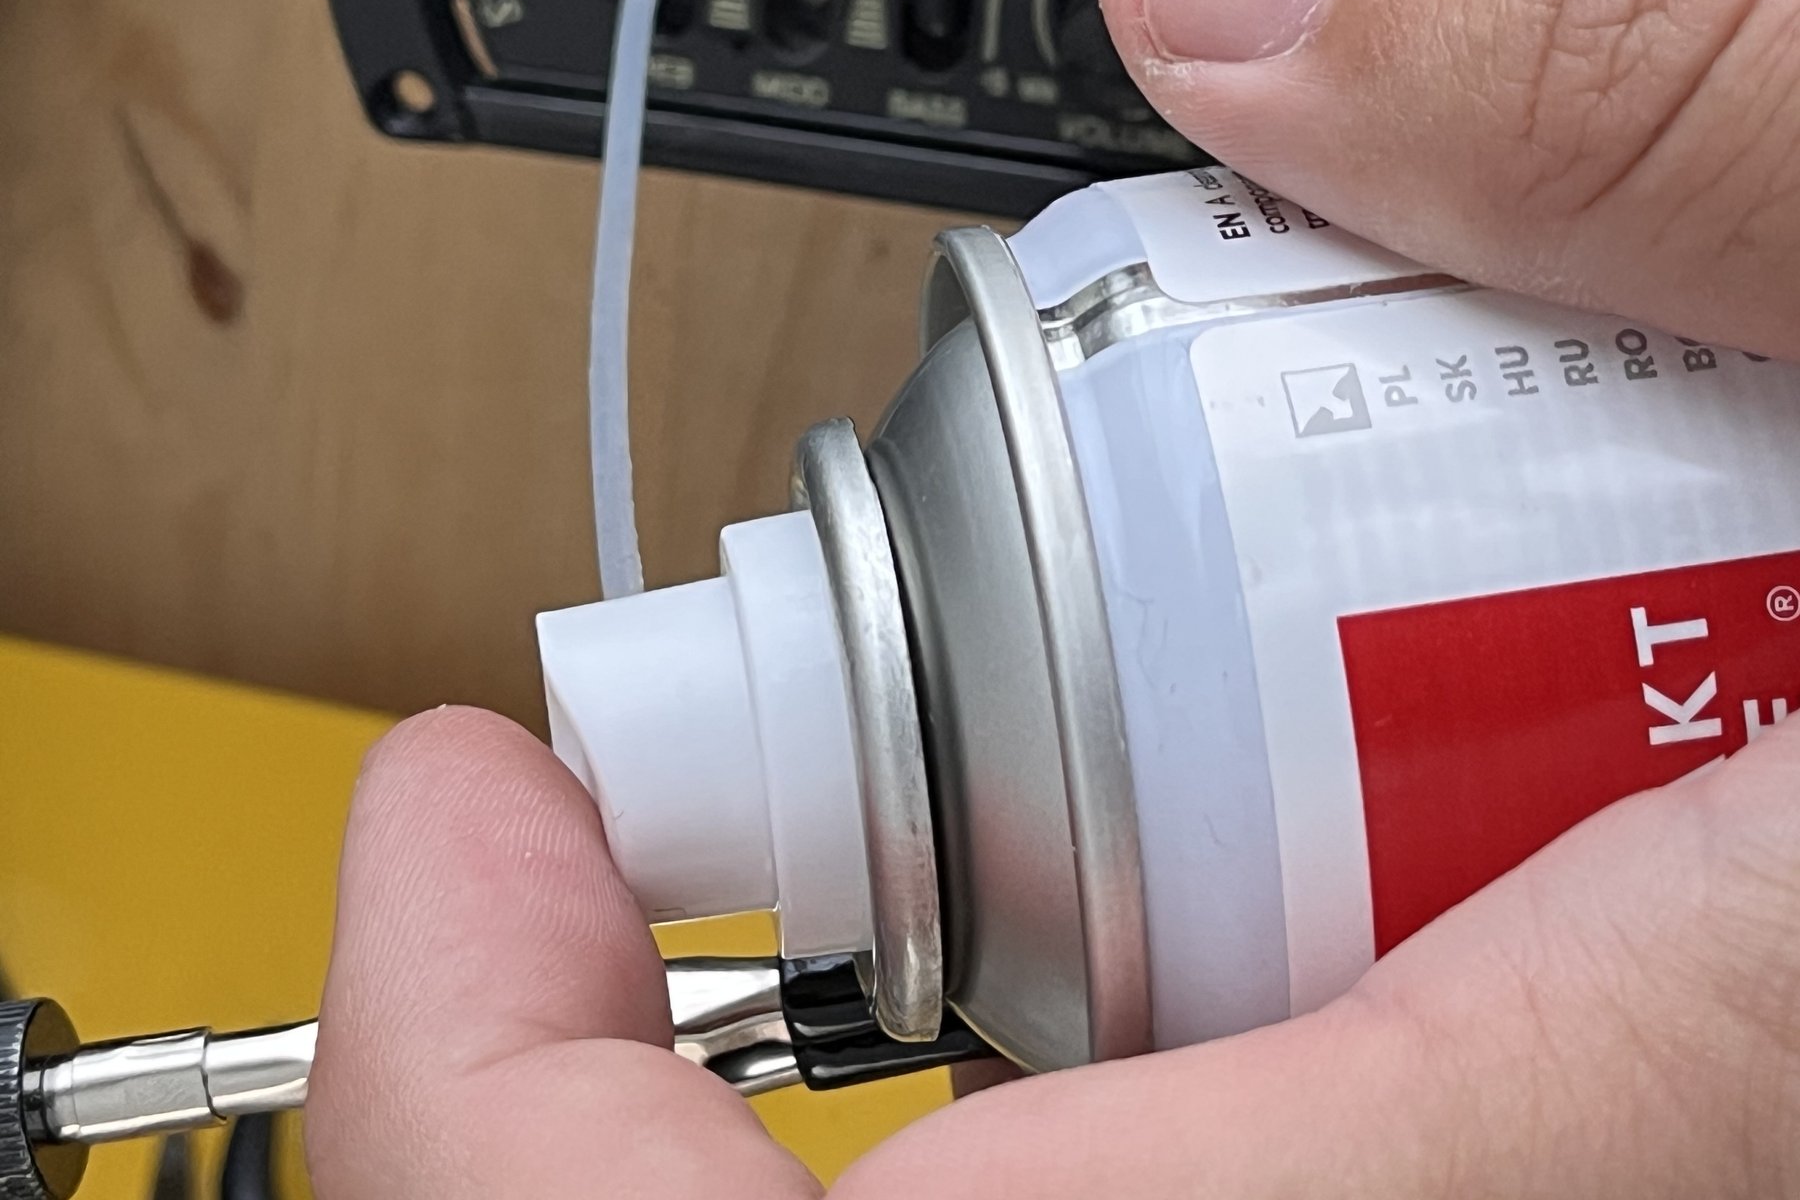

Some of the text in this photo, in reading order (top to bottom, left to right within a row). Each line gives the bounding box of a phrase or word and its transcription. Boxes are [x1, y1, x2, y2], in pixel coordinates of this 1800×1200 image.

[1205, 194, 1235, 205] A
[1213, 212, 1251, 240] EN
[1495, 345, 1539, 396] HU
[1553, 338, 1599, 386] RU
[1615, 328, 1658, 380] RO
[1674, 336, 1717, 372] B
[1378, 364, 1419, 407] PL
[1435, 354, 1477, 403] SK
[1630, 606, 1724, 765] KT
